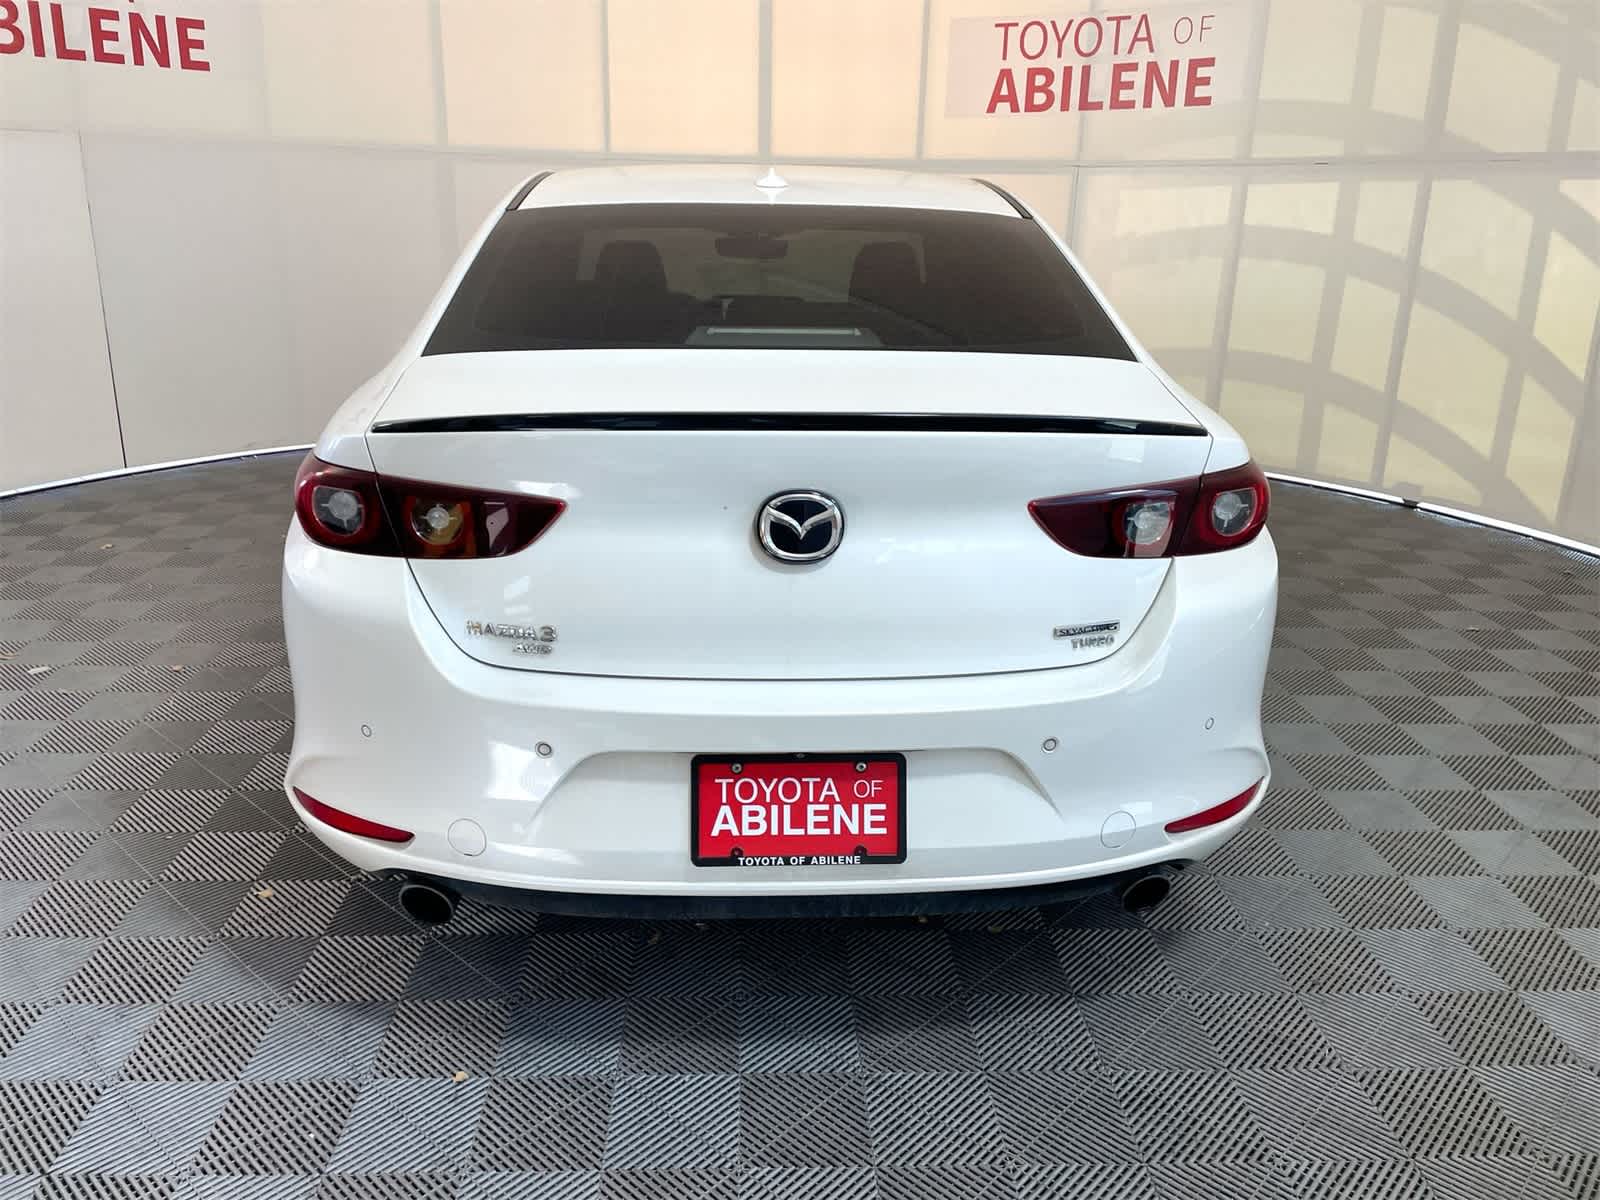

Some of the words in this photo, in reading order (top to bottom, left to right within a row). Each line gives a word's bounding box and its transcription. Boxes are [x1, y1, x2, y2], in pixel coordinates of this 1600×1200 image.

[994, 14, 1155, 61] TOYOTA
[1173, 15, 1216, 45] OF
[986, 57, 1216, 114] ABILENE
[714, 777, 841, 804] TOYOTA
[853, 779, 884, 798] OF
[710, 803, 888, 837] ABILENE
[738, 857, 785, 866] TOYOTA
[790, 857, 806, 865] OF
[810, 856, 861, 865] ABILENE
